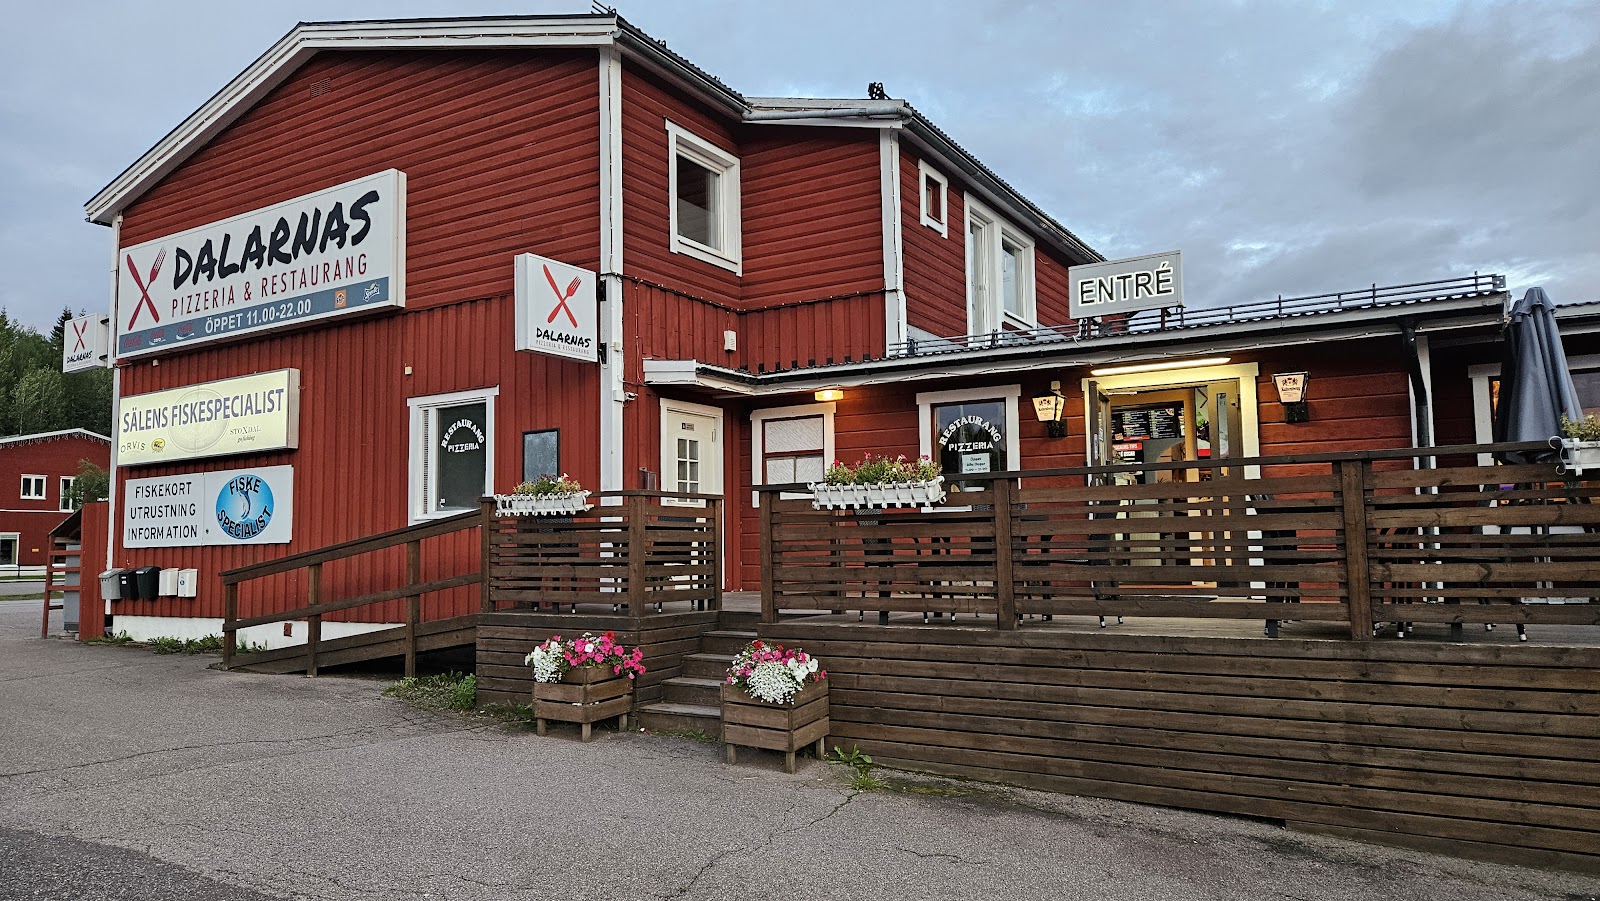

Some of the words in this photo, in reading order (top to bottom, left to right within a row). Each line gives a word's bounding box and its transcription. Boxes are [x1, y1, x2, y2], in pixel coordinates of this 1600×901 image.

[173, 190, 380, 291] DALARNAS
[171, 286, 235, 318] PIZZERIA
[243, 281, 252, 301] &
[261, 253, 368, 296] RESTAURANG
[1078, 261, 1174, 307] ENTRÉ
[205, 312, 244, 334] ÖPPET
[246, 298, 312, 326] 11.00-22.00
[536, 327, 592, 348] DALARNAS
[123, 406, 168, 433] SÄLENS
[171, 388, 285, 427] FISKESPECIALIST
[441, 418, 485, 449] RESTAURANG
[939, 415, 1002, 446] RESTAURANG
[120, 441, 146, 453] ORVIS
[447, 442, 480, 453] PIZZERIA
[948, 441, 994, 452] PIZZERIA
[135, 481, 192, 499] FISKEKORT
[229, 476, 262, 495] FISKE
[130, 503, 196, 520] UTRUSTNING
[217, 505, 272, 538] SPECIALIST
[127, 525, 198, 541] INFORMATION
